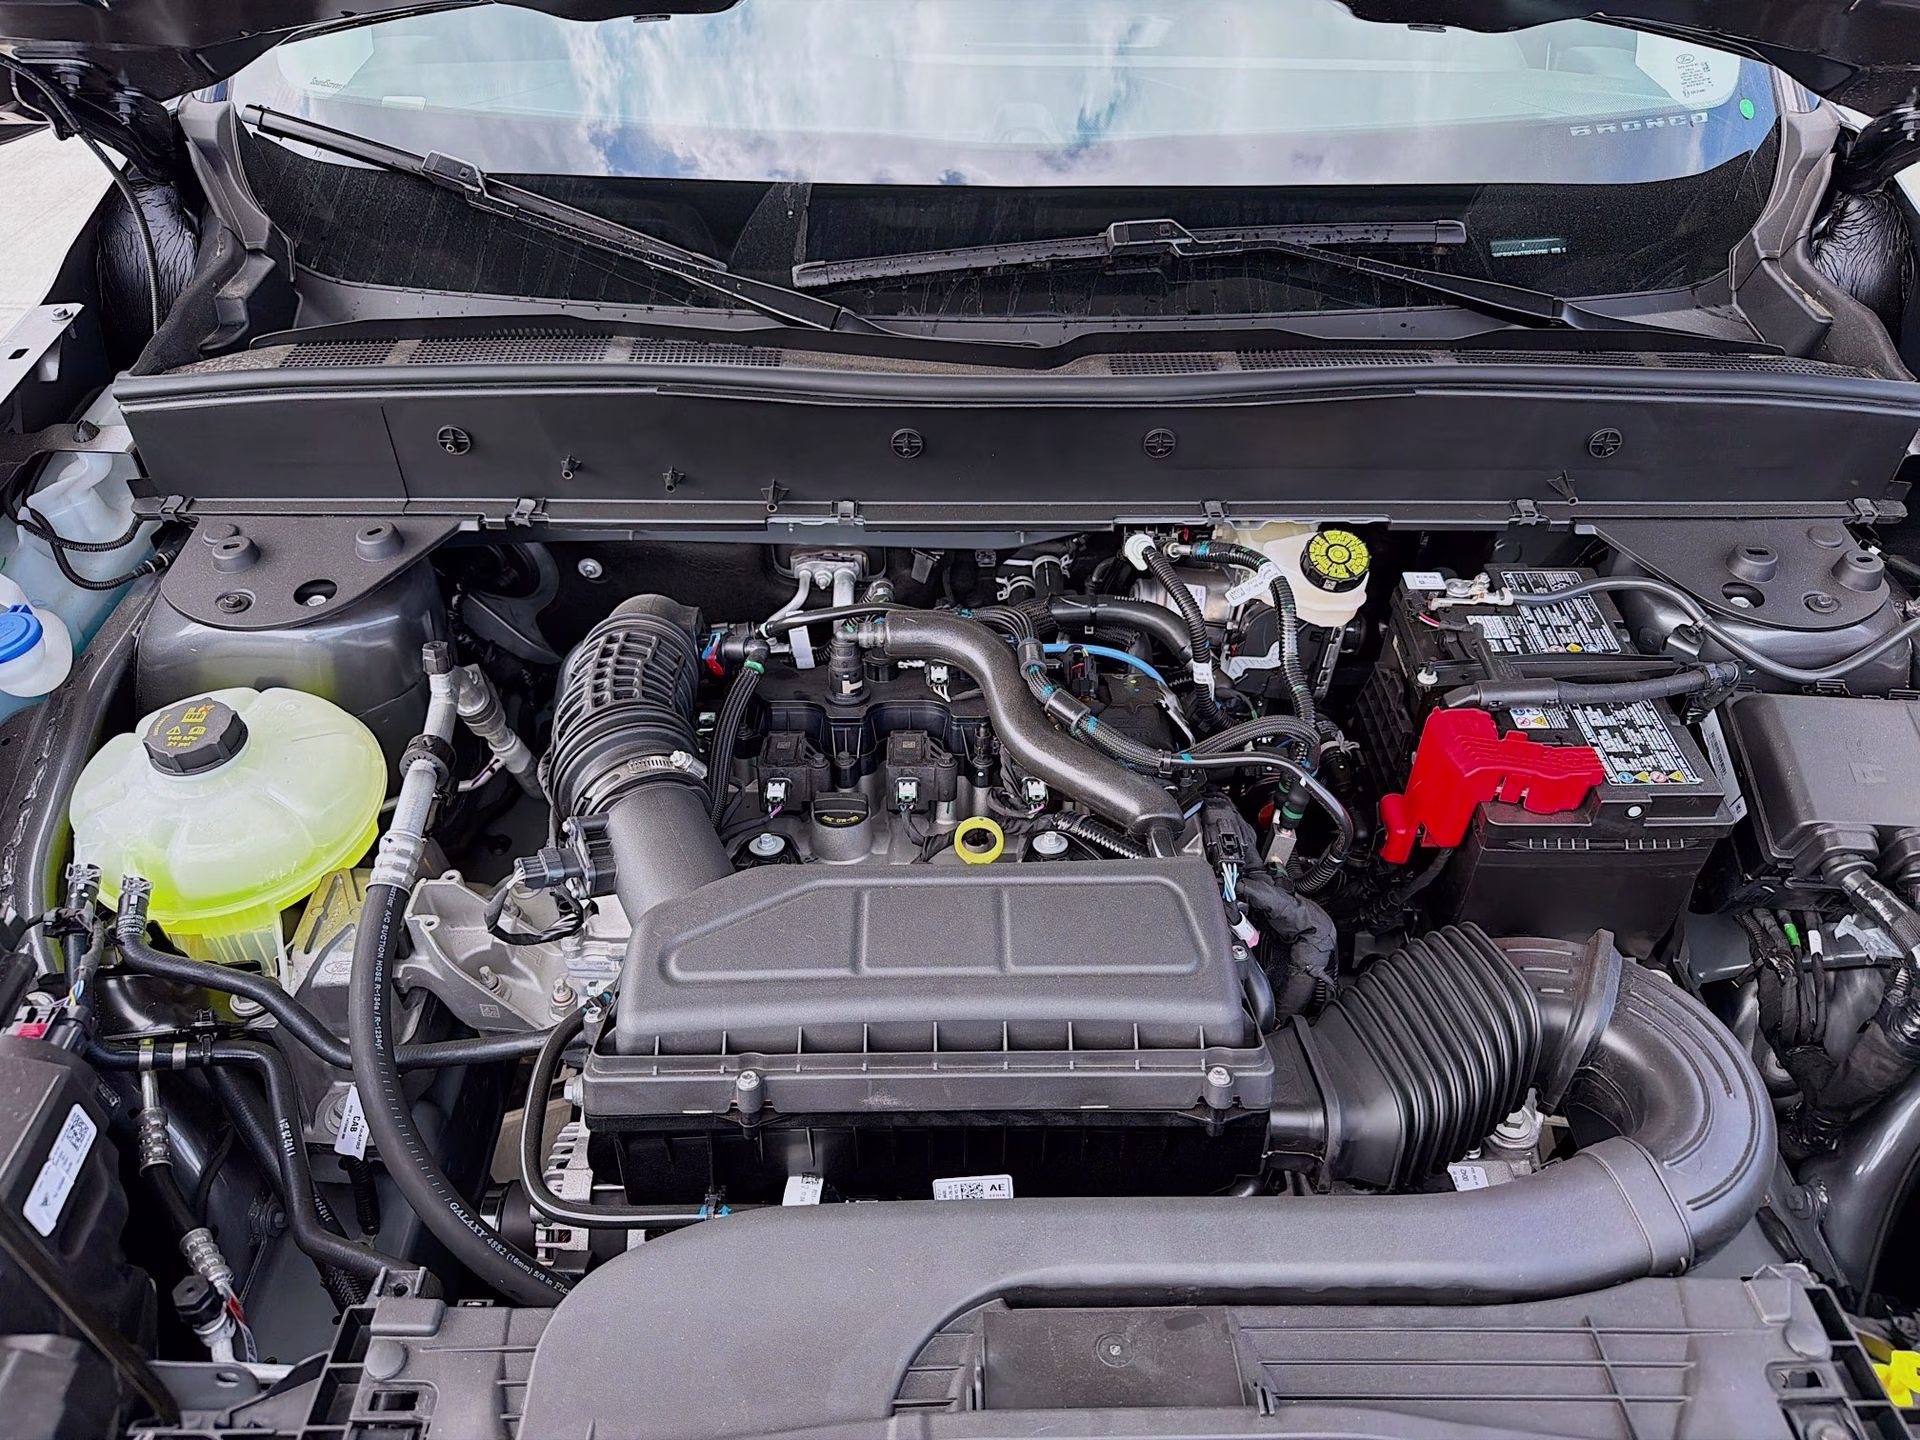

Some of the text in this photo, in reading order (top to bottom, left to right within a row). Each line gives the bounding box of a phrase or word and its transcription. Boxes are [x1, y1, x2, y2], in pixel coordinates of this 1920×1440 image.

[1569, 111, 1709, 137] BRONCO
[378, 925, 389, 958] SUCTION
[350, 1115, 361, 1132] CAB
[989, 1183, 1006, 1192] AE
[449, 1202, 488, 1238] GALAXY
[486, 1238, 508, 1256] 4882
